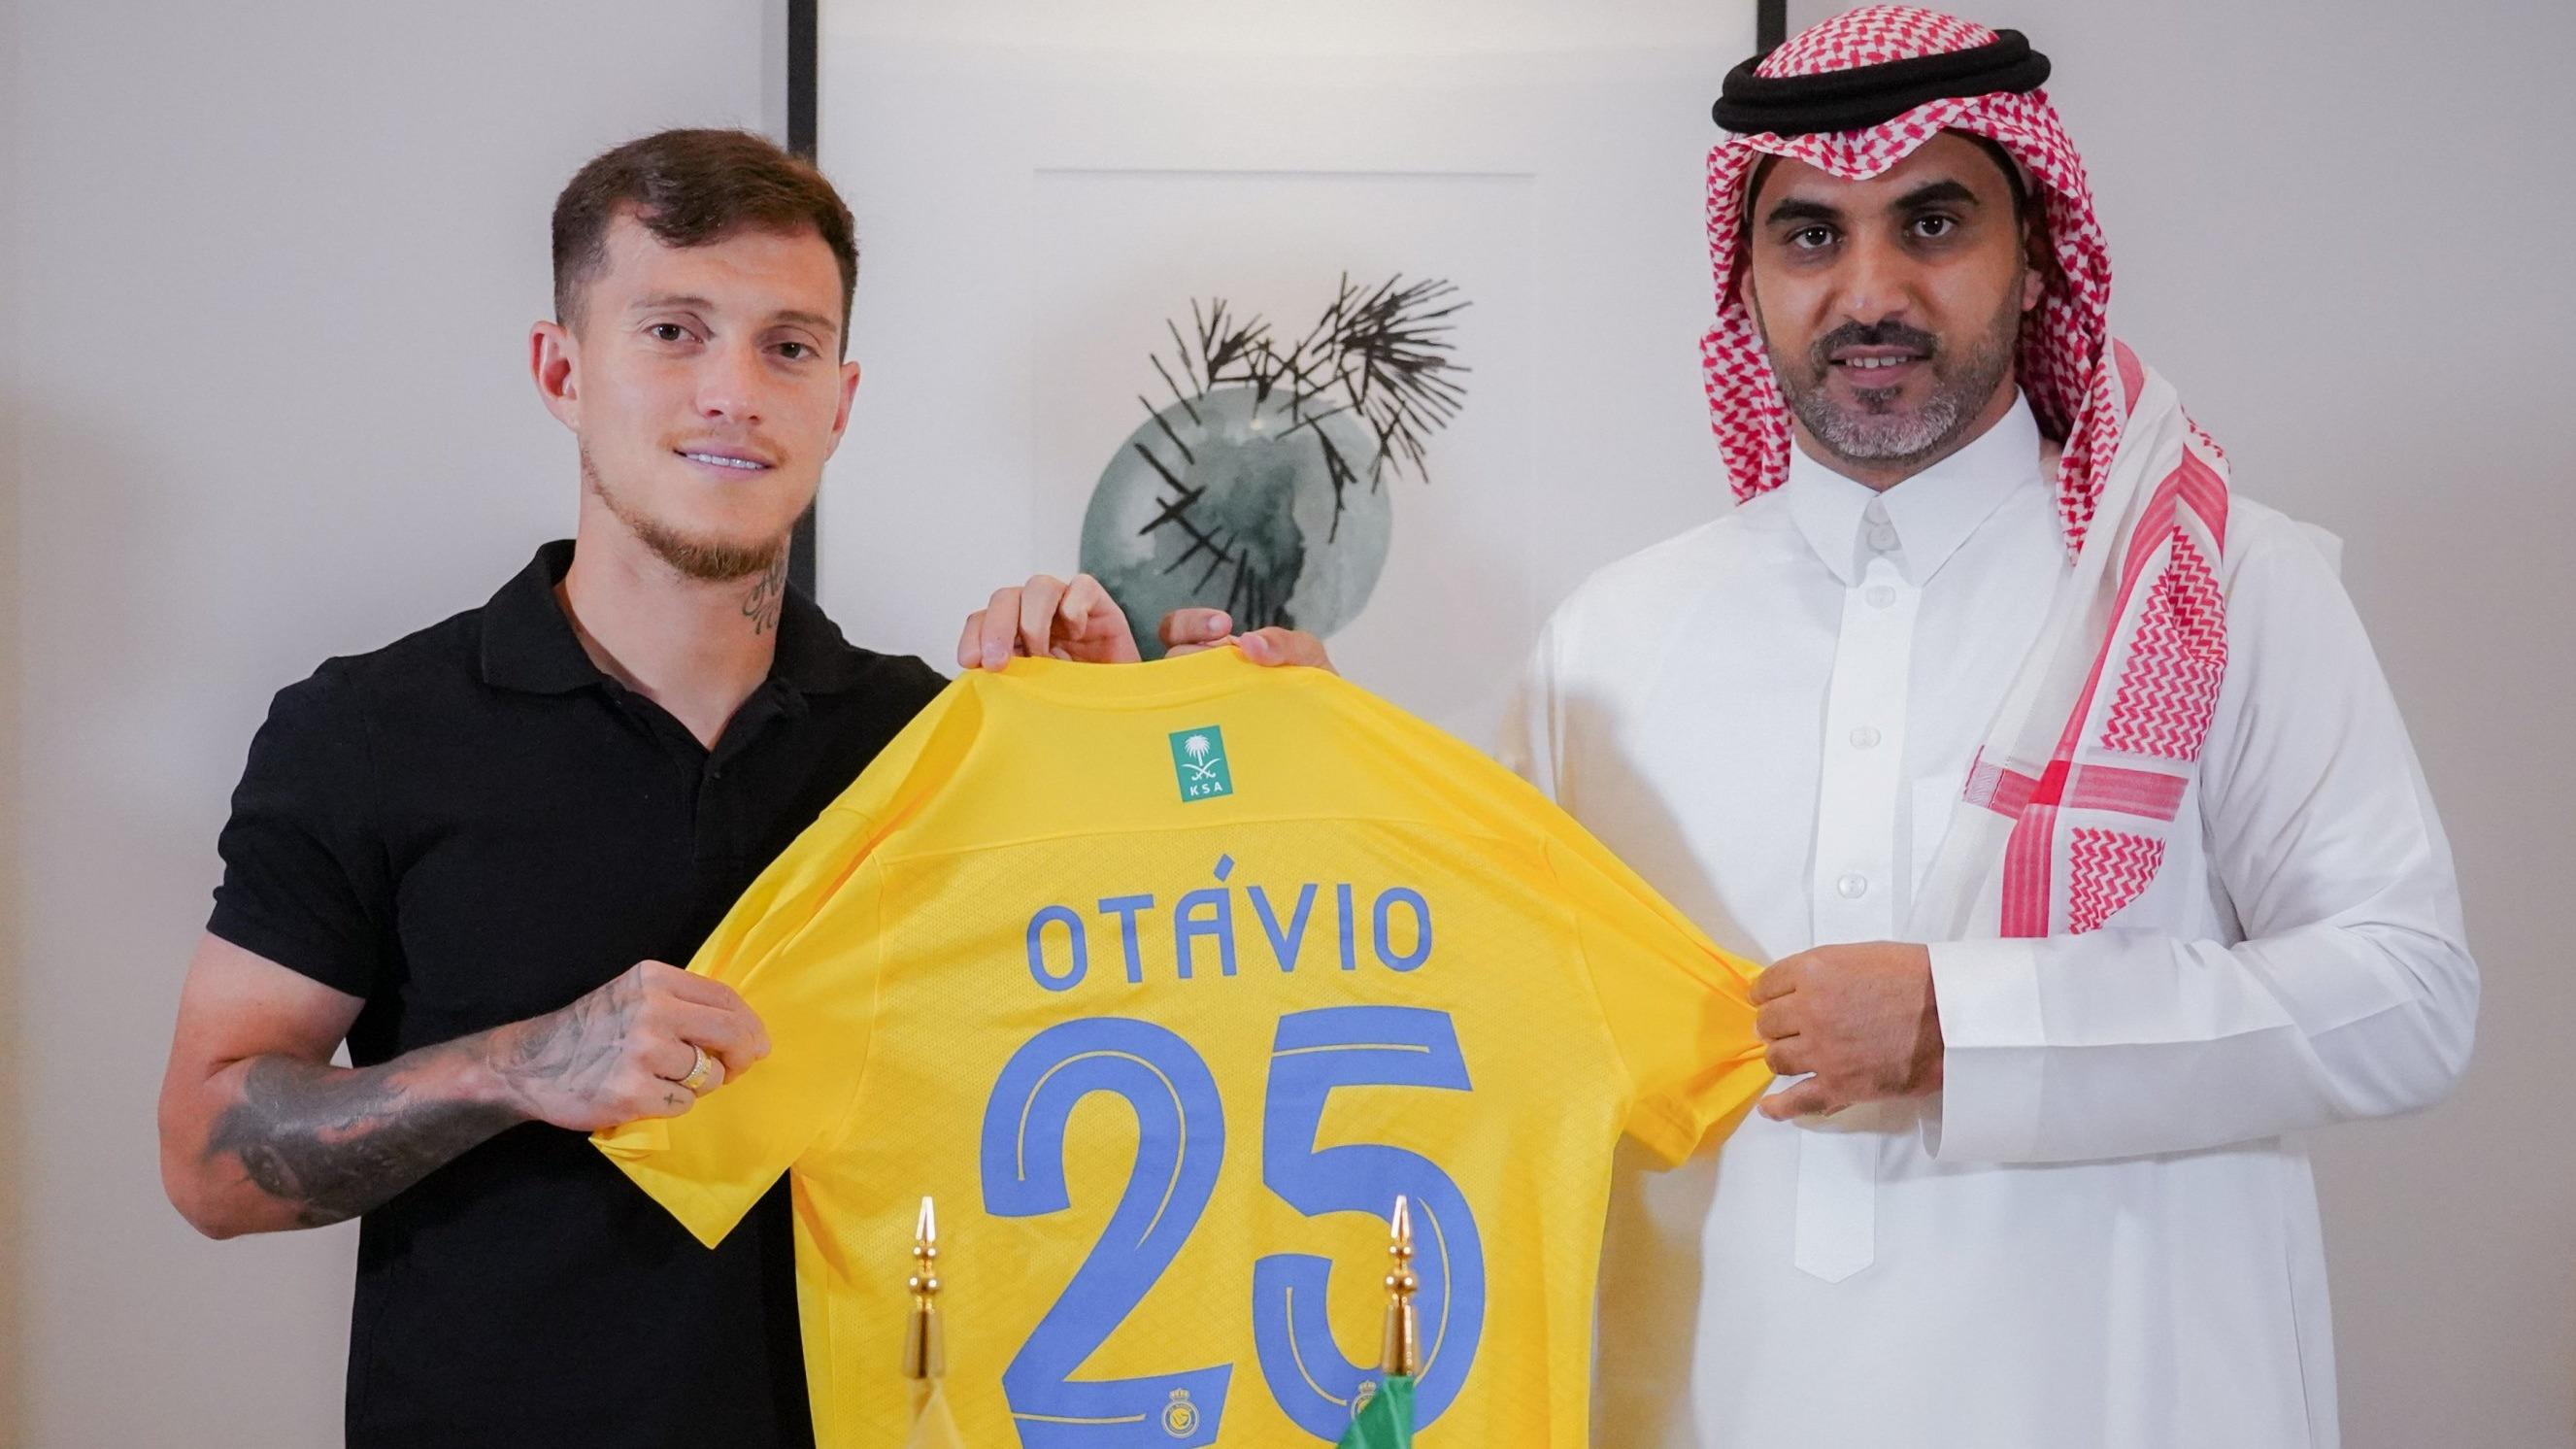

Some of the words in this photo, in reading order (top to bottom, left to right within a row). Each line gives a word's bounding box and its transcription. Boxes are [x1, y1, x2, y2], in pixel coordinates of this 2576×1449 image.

[1189, 781, 1223, 796] KSA
[1026, 853, 1432, 993] OTÁVIO
[980, 1005, 1486, 1449] 25
